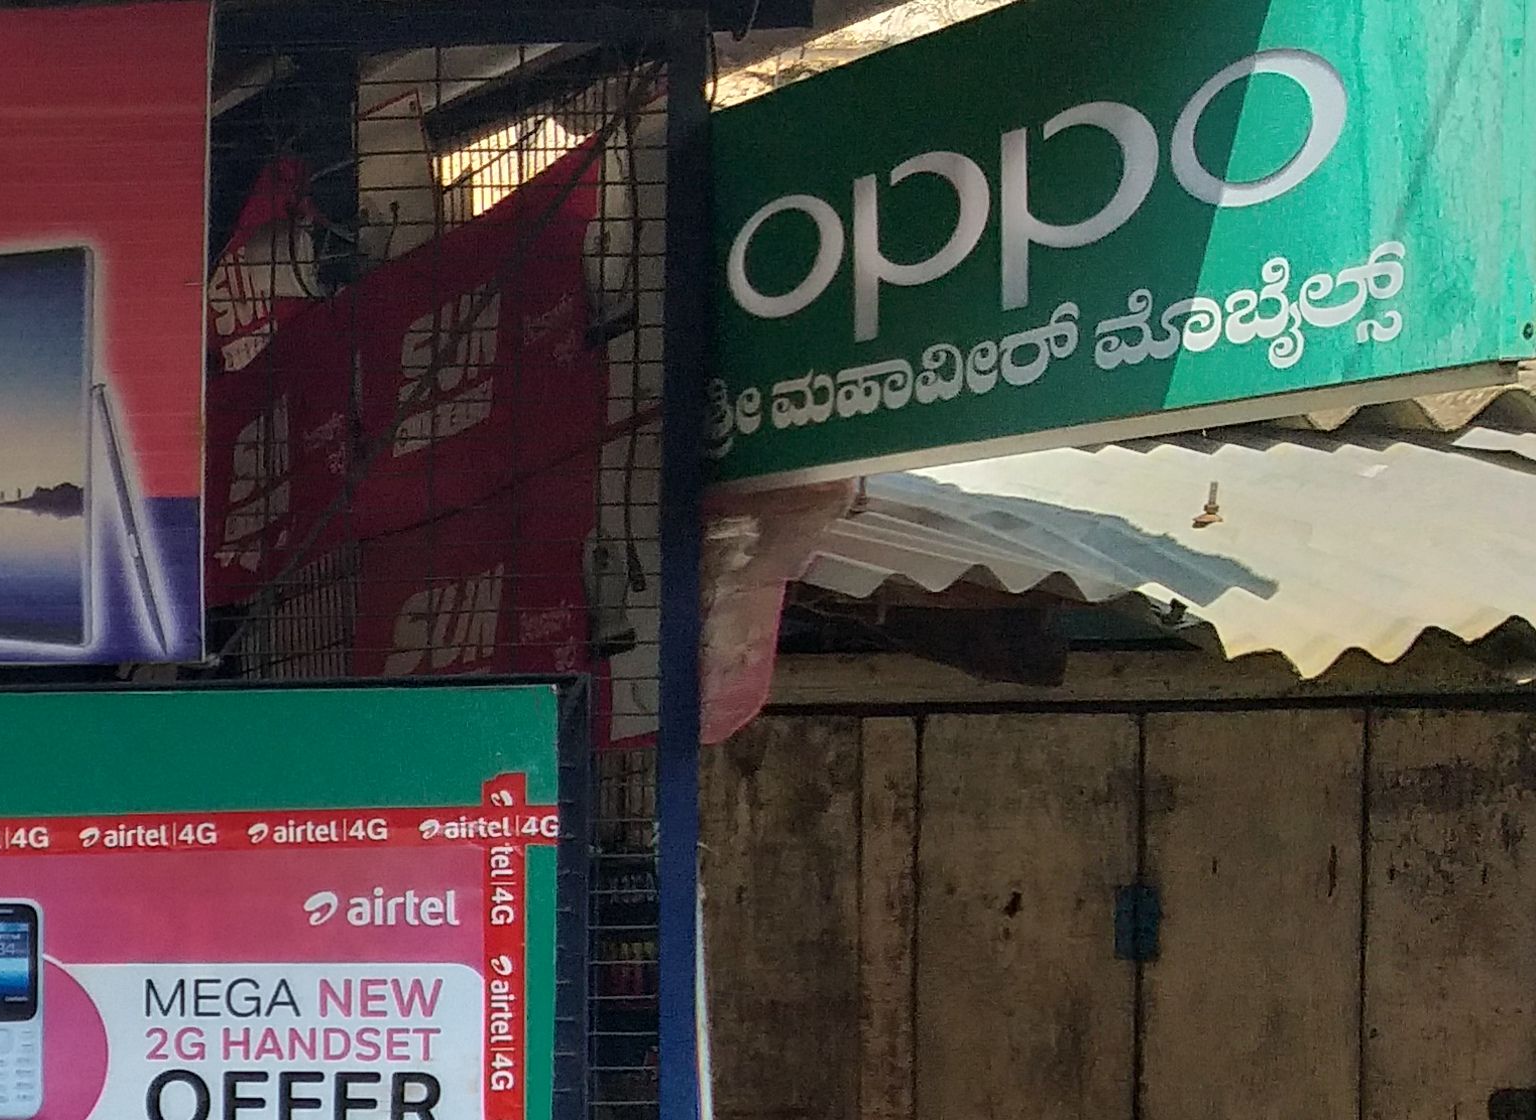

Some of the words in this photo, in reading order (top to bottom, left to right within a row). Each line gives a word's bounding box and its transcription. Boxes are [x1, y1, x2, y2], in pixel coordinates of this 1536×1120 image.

[771, 301, 1080, 431] ಮಹಾವೀರ್
[1094, 240, 1406, 370] ಮೊಬೈಲ್ಸ್
[10, 828, 49, 849] 4G
[103, 824, 168, 847] airtel
[178, 823, 217, 844] 4G
[346, 887, 460, 926] airtel
[144, 978, 301, 1018] MEGA
[317, 977, 443, 1018] NEW
[145, 1028, 206, 1062] 2G
[221, 1027, 441, 1062] HANDSET
[491, 1053, 514, 1092] 4G
